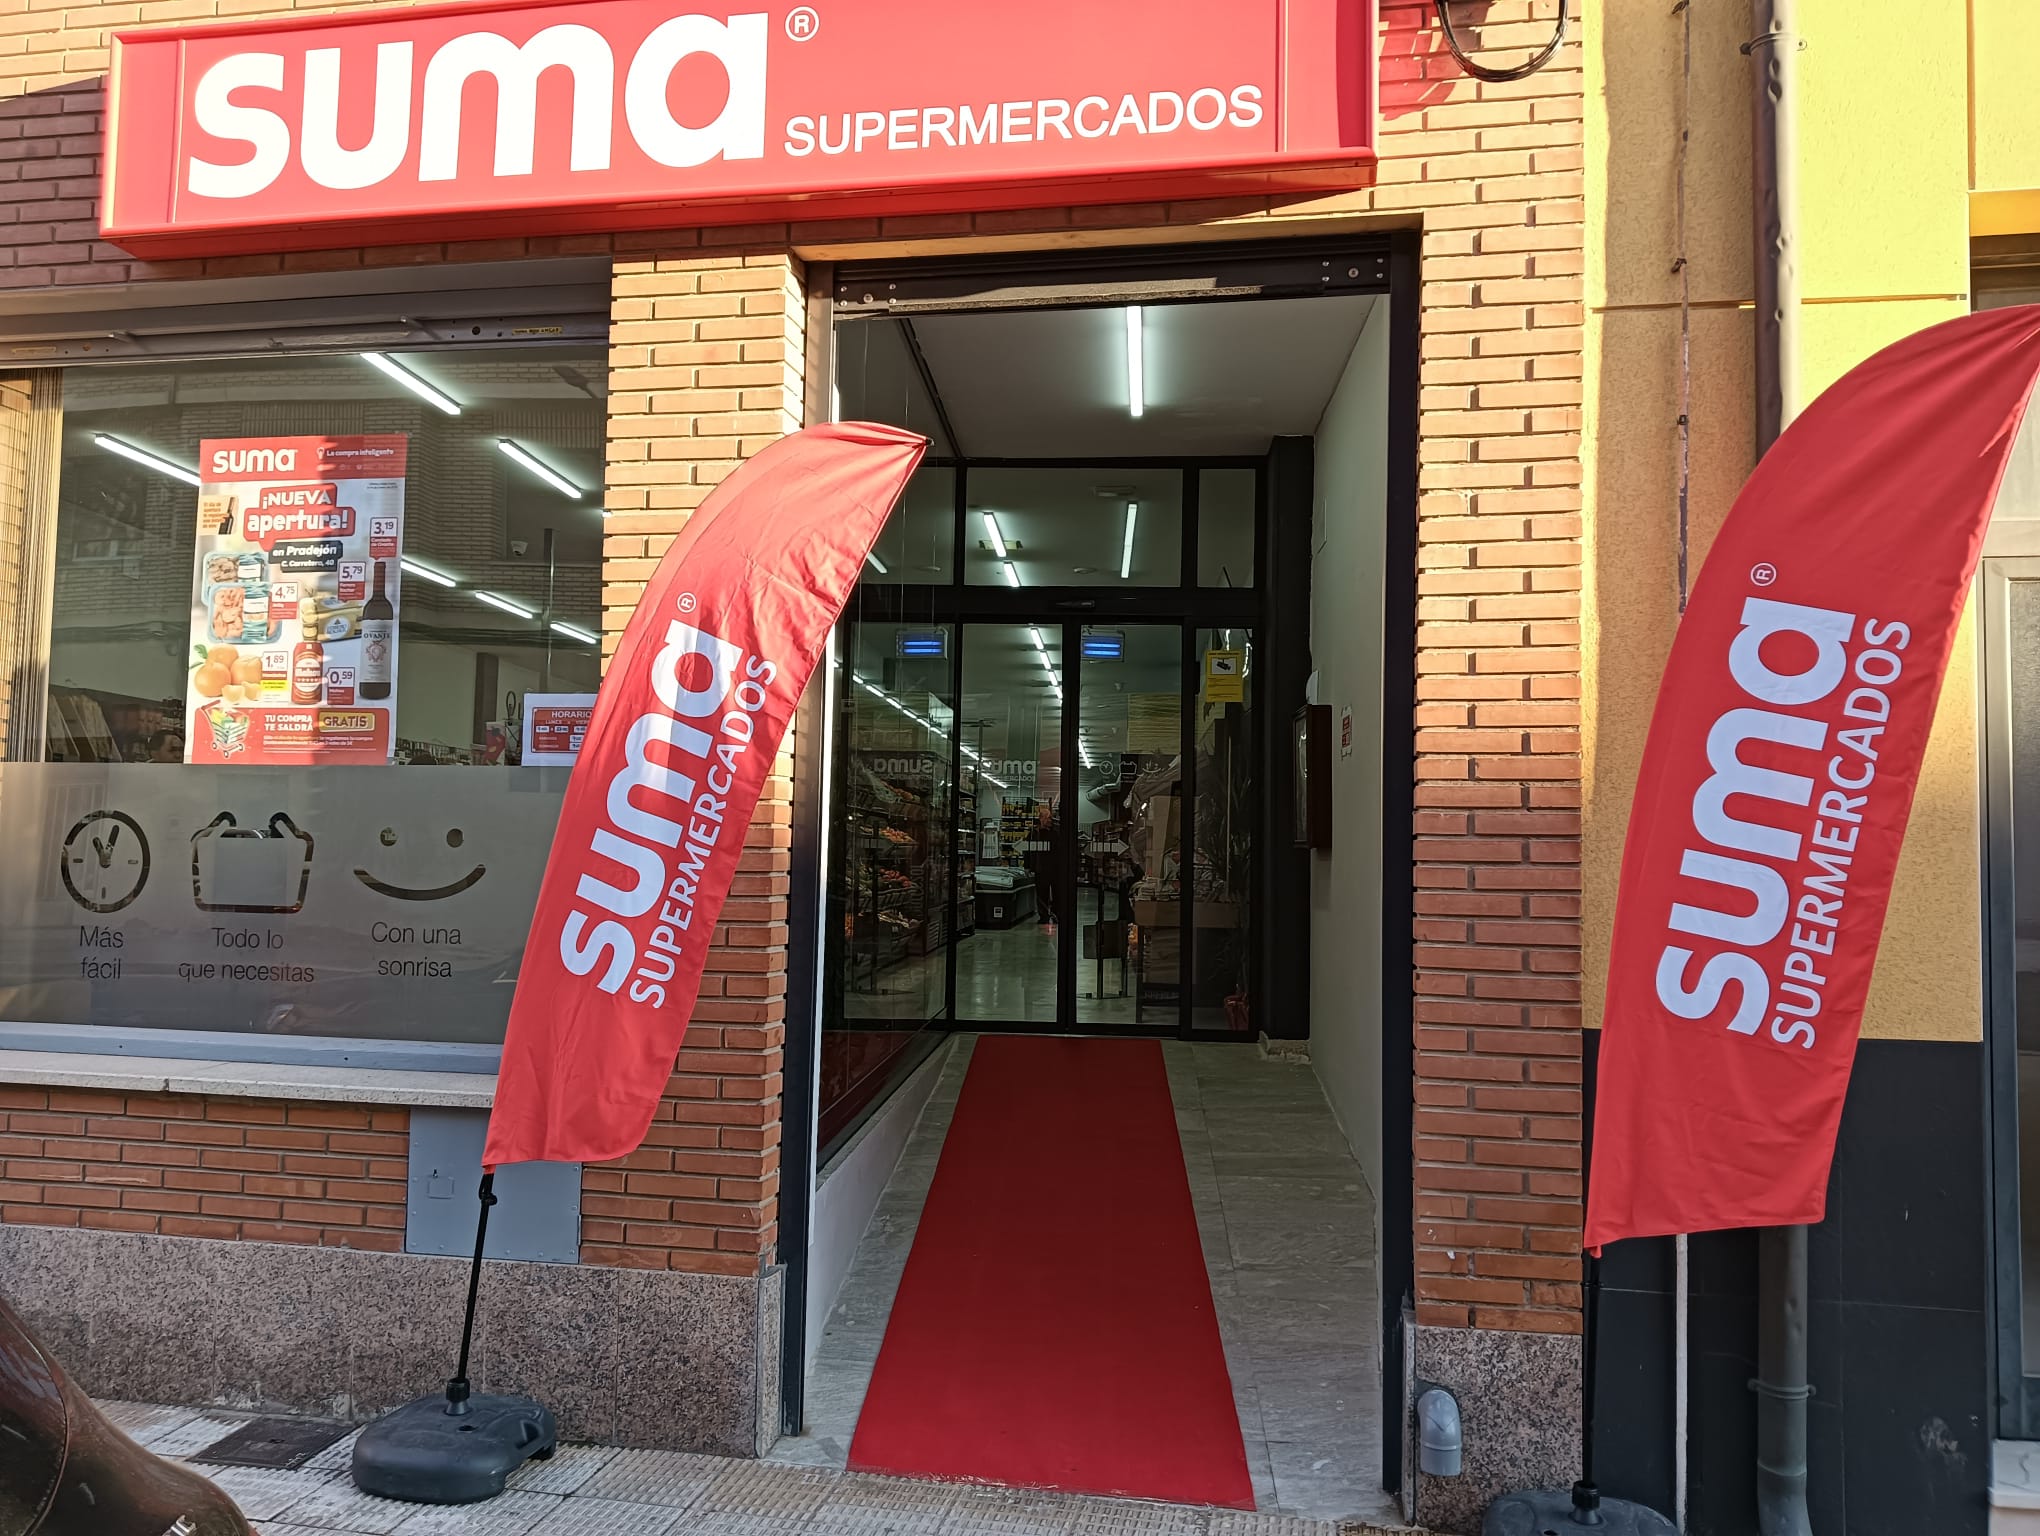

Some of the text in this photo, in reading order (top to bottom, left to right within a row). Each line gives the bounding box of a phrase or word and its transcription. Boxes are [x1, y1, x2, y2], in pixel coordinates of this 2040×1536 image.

[188, 12, 769, 198] suma
[784, 85, 1263, 156] SUPERMERCADOS
[212, 449, 295, 474] suma
[262, 490, 332, 510] ¡NUEVA
[247, 509, 348, 539] apertura!
[272, 544, 337, 557] en Pradejón
[329, 671, 353, 685] 0,59
[277, 714, 313, 723] COMPRA
[323, 715, 368, 727] GRATIS
[560, 619, 743, 995] suma
[1655, 597, 1857, 1036] suma
[629, 654, 778, 1009] SUPERMERCADOS
[1771, 618, 1911, 1049] SUPERMERCADOS
[79, 925, 124, 948] Más
[211, 927, 284, 949] Todo lo
[371, 921, 462, 944] Con una
[80, 956, 121, 980] fácil
[178, 962, 314, 983] que necesitas
[377, 956, 452, 978] sonrisa
